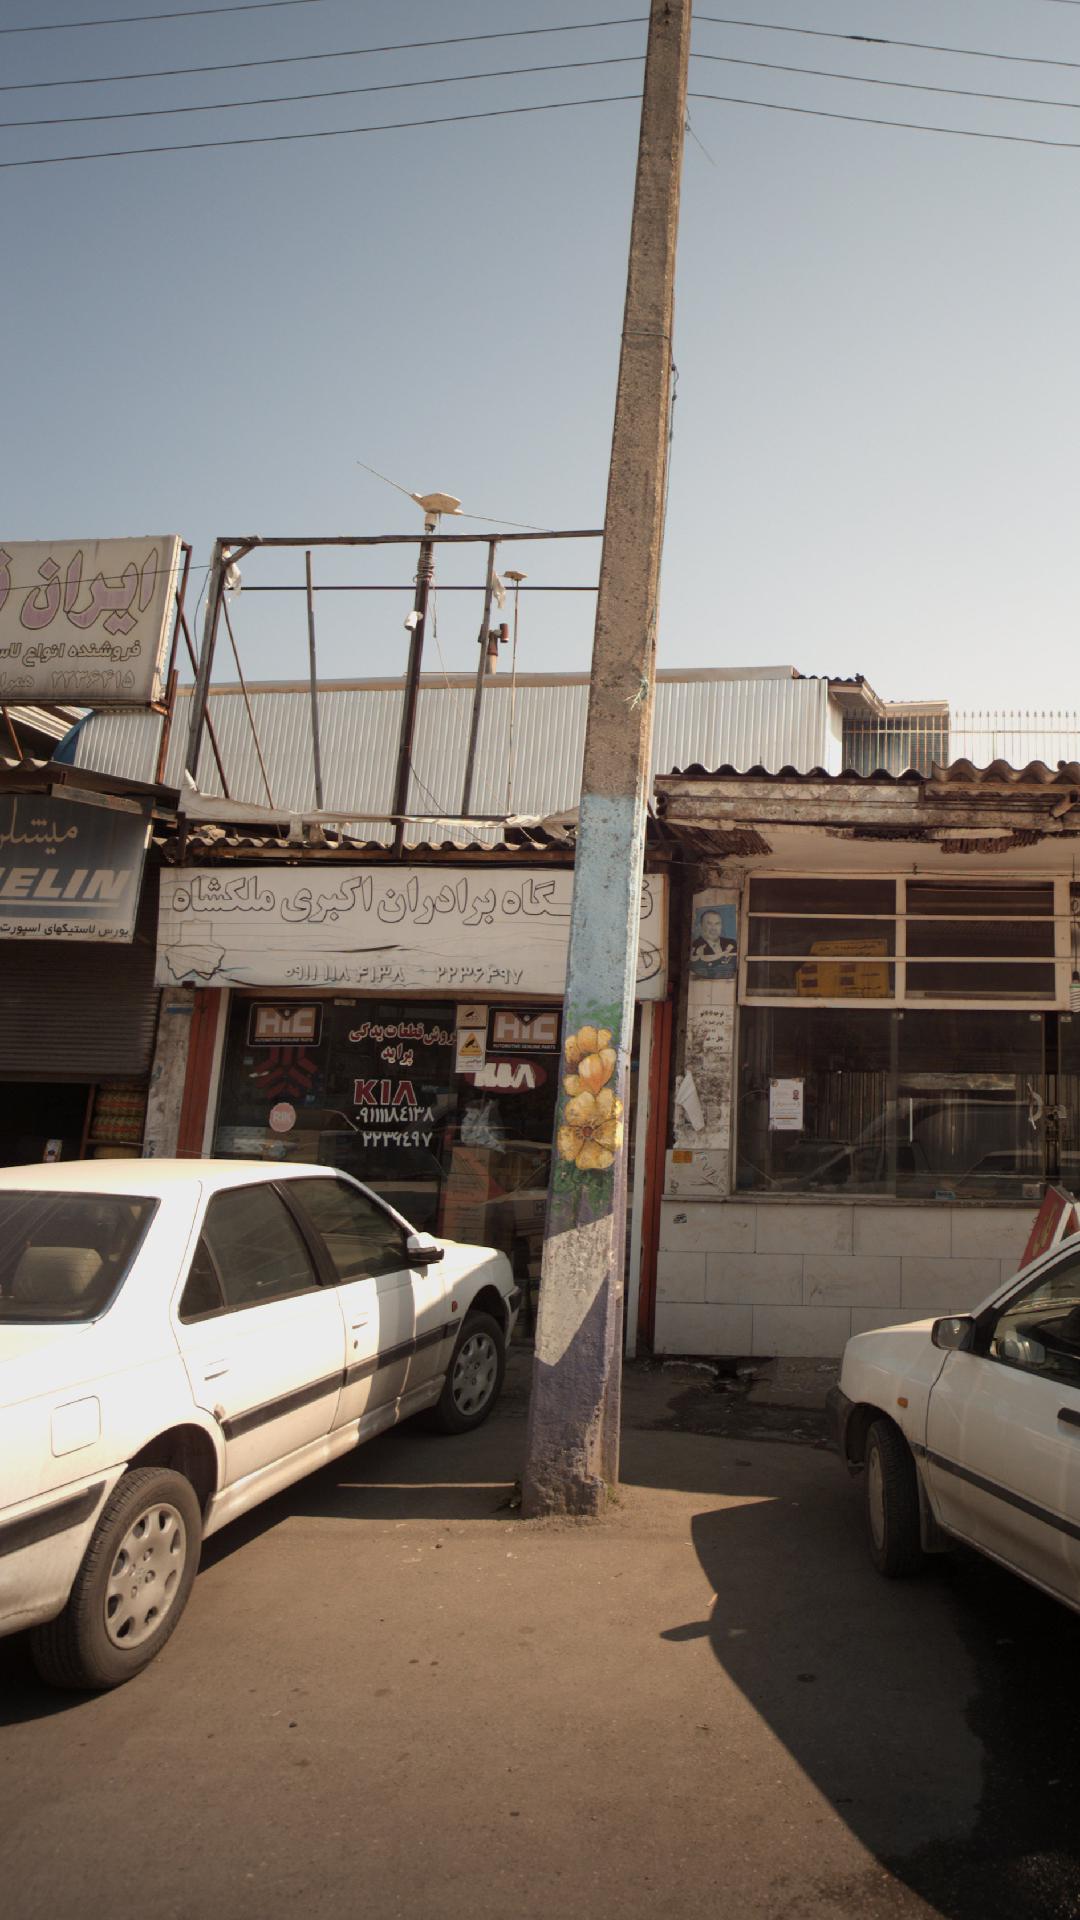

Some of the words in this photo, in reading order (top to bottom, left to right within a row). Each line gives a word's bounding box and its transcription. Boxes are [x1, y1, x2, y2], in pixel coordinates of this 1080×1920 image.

[20, 548, 158, 636] ایران
[0, 642, 22, 659] لاس
[22, 643, 65, 667] انواع
[68, 640, 141, 662] فروشنده
[0, 671, 35, 692] همرا
[0, 867, 131, 899] ELIN
[172, 876, 276, 912] ملکشاه
[281, 876, 373, 922] اکبری
[377, 875, 496, 925] برادران
[353, 1079, 418, 1106] KIA
